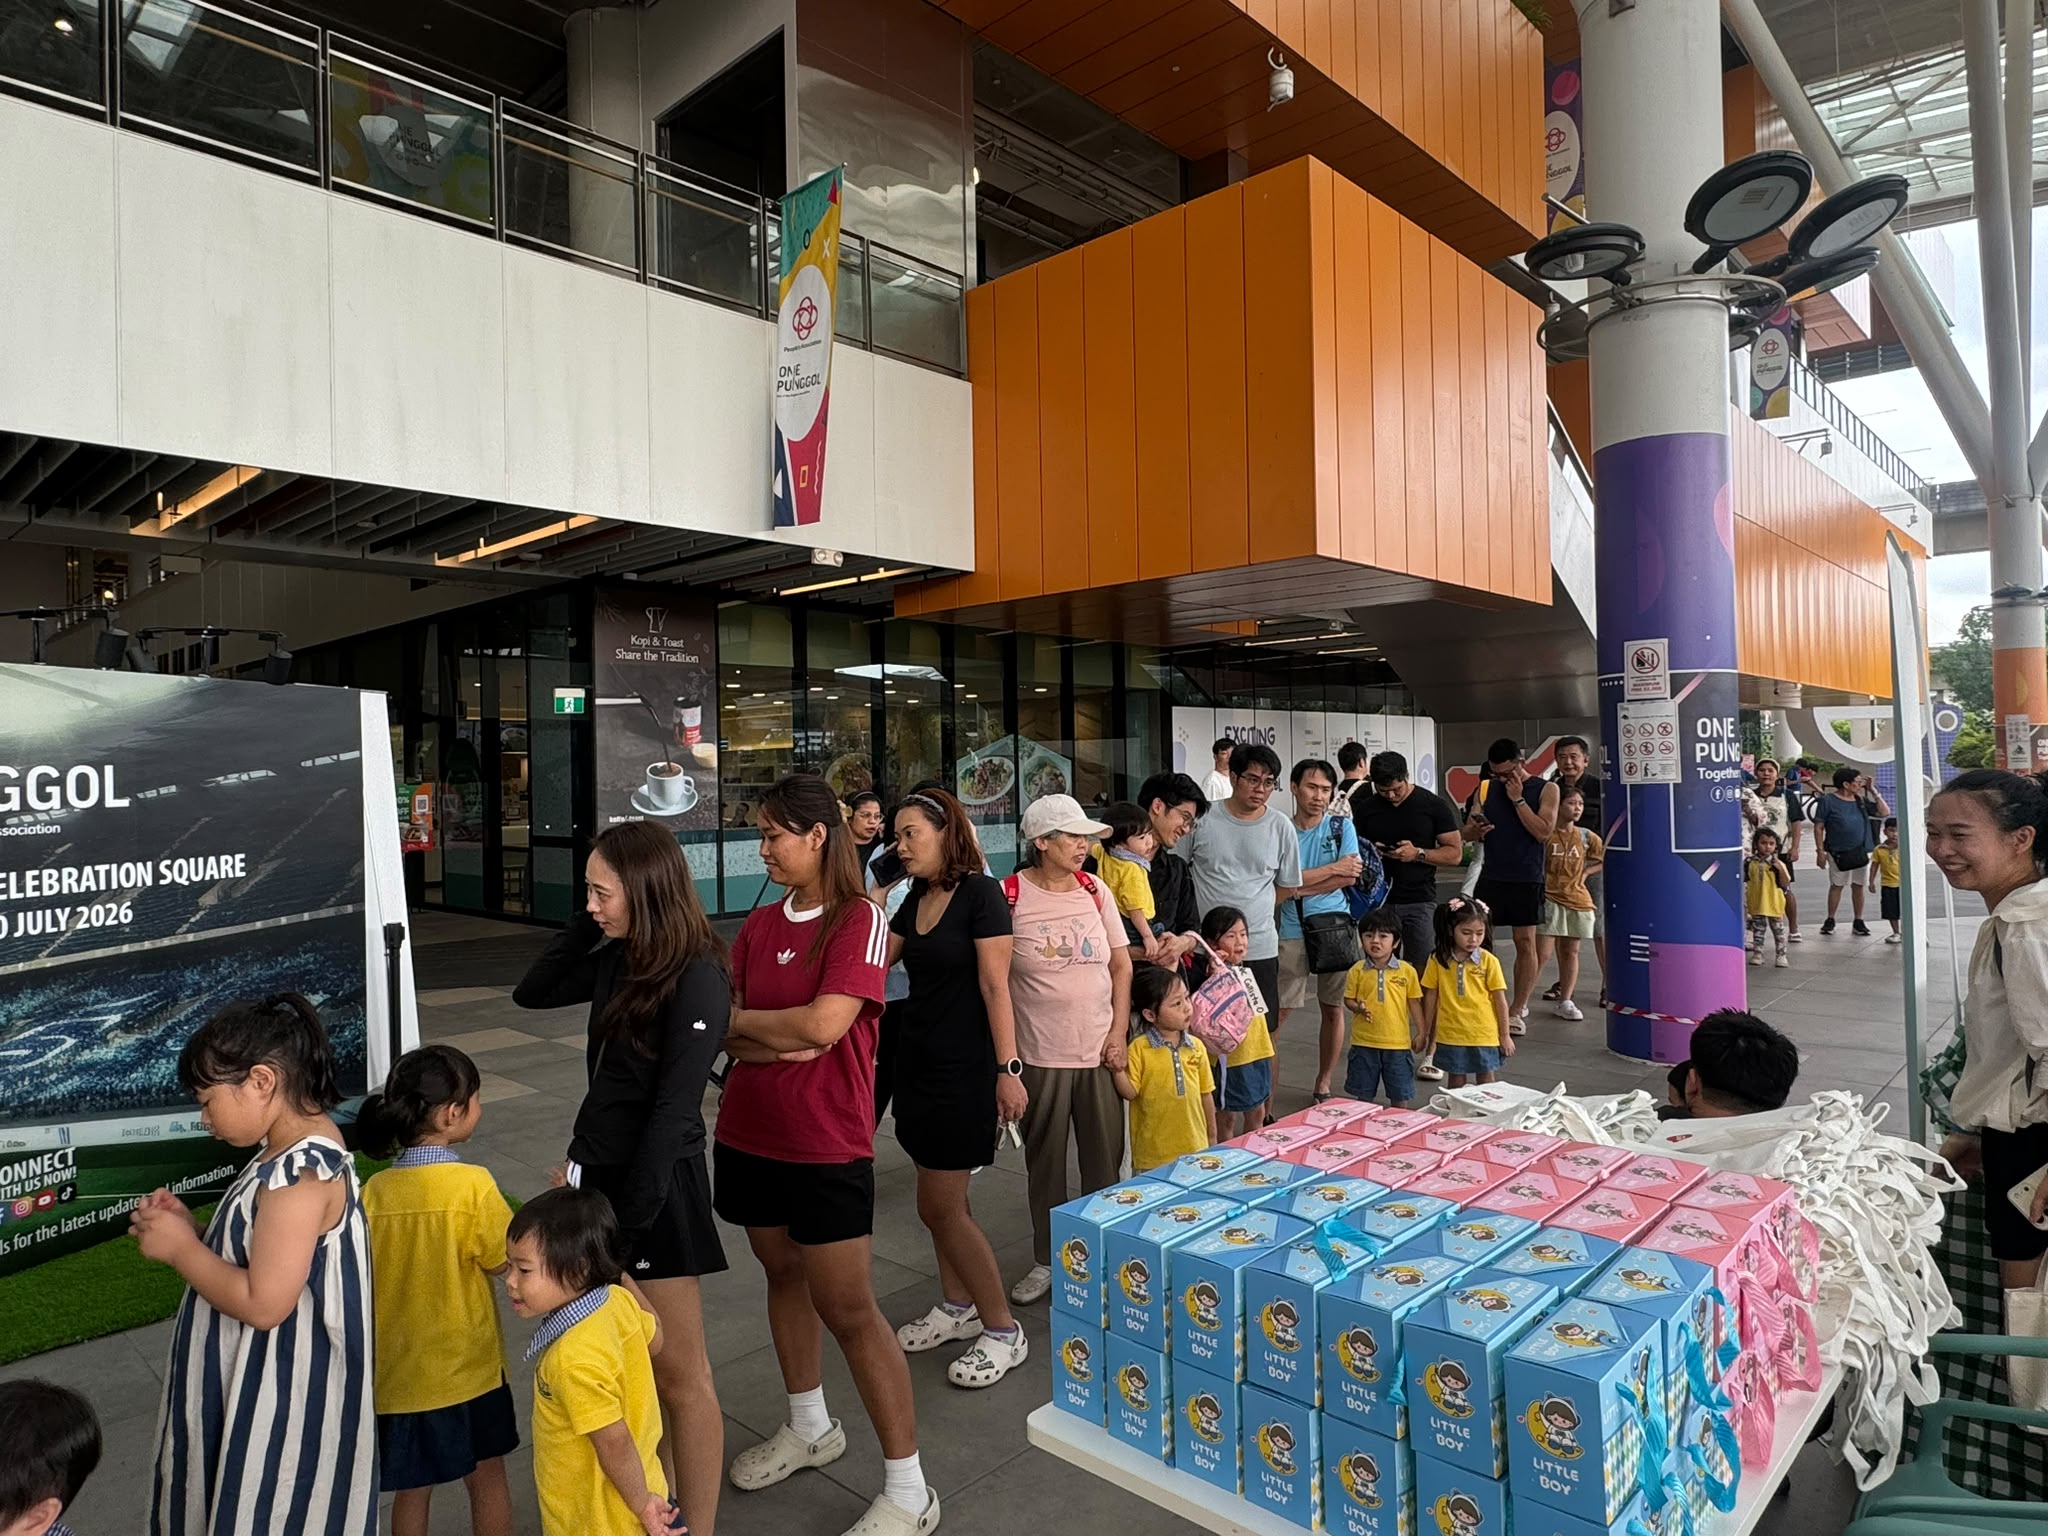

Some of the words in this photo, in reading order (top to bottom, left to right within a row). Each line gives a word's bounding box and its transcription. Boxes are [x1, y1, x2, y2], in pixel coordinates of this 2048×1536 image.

[779, 364, 801, 378] ONE
[776, 373, 821, 392] PUNGGOL
[631, 635, 651, 648] Kopi
[652, 637, 660, 647] &
[662, 637, 684, 648] Toast
[616, 648, 641, 660] Share
[643, 650, 658, 662] the
[660, 651, 699, 664] Tradition
[1225, 726, 1275, 746] EXCITING
[1696, 717, 1735, 738] ONE
[158, 853, 246, 886] SQUARE
[13, 906, 72, 938] JULY
[75, 901, 134, 929] 2026
[24, 1176, 41, 1192] US
[43, 1165, 77, 1187] NOW!
[14, 1231, 34, 1251] for
[36, 1224, 58, 1242] the
[61, 1213, 96, 1235] latest
[99, 1195, 145, 1222] update
[172, 1164, 237, 1194] information.
[636, 1258, 650, 1269] alo
[1064, 1281, 1088, 1298] LITTLE
[1066, 1294, 1084, 1308] BOY
[1122, 1304, 1149, 1322] LITTLE
[1126, 1318, 1145, 1332] BOY
[1188, 1329, 1218, 1348] LITTLE
[1191, 1344, 1212, 1359] BOY
[1264, 1350, 1297, 1370] LITTLE
[1268, 1365, 1290, 1382] BOY
[1066, 1380, 1090, 1397] LITTLE
[1342, 1380, 1377, 1402] LITTLE
[1068, 1393, 1086, 1408] BOY
[1346, 1396, 1370, 1414] BOY
[1121, 1408, 1147, 1428] LITTLE
[1430, 1416, 1471, 1439] LITTLE
[1124, 1422, 1143, 1438] BOY
[1190, 1440, 1220, 1461] LITTLE
[1436, 1433, 1464, 1452] BOY
[1194, 1455, 1215, 1471] BOY
[1533, 1457, 1580, 1482] LITTLE
[1261, 1472, 1294, 1494] LITTLE
[1540, 1475, 1571, 1496] BOY
[1265, 1486, 1286, 1504] BOY
[1343, 1503, 1378, 1529] LITTLE
[1348, 1520, 1372, 1536] BOY
